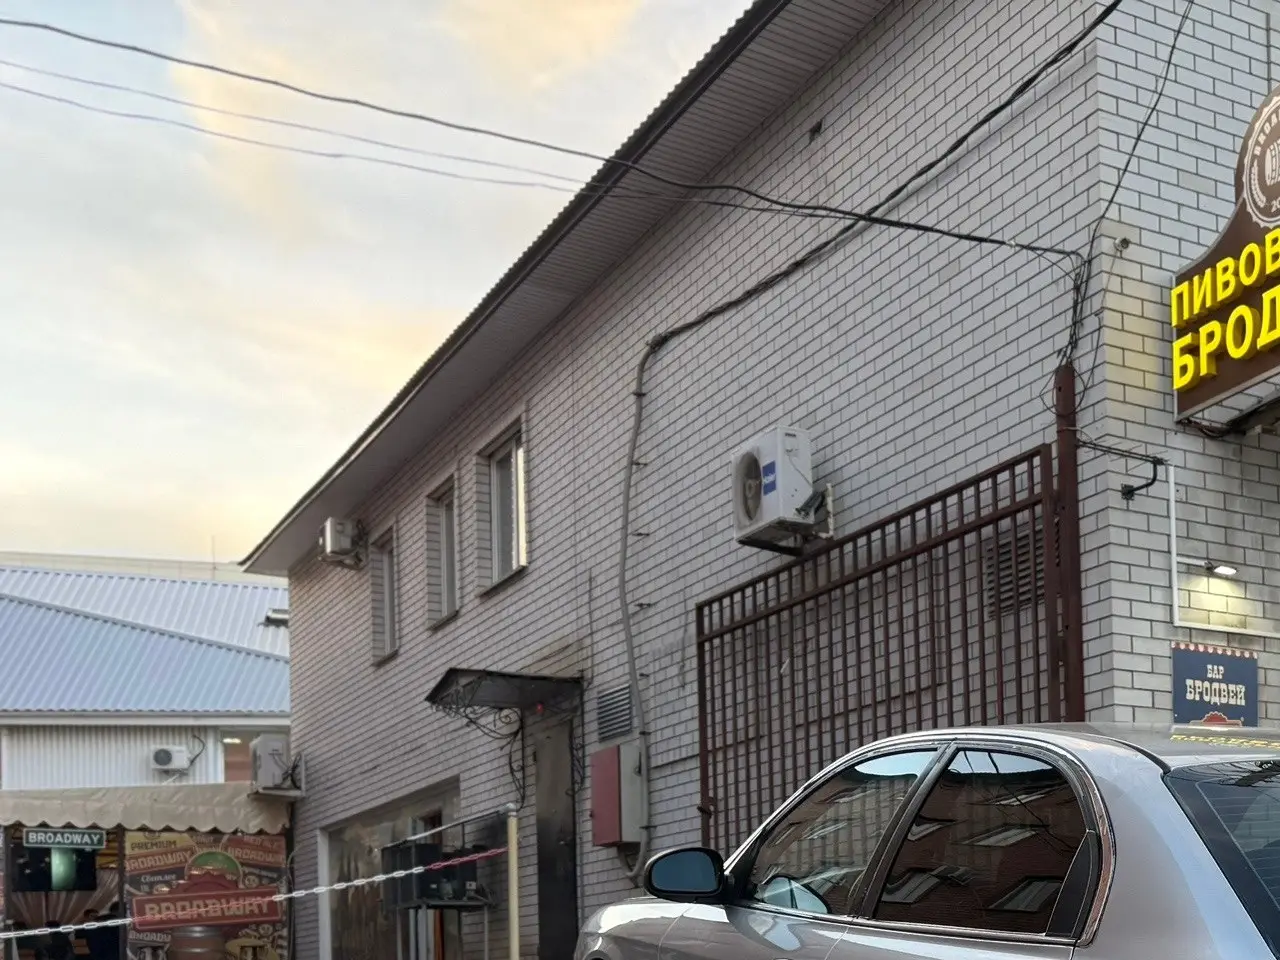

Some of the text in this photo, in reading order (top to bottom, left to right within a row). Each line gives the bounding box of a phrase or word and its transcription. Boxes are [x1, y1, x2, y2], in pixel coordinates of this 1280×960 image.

[1206, 664, 1225, 679] БАР
[1185, 678, 1246, 707] БРОДВЕЙ
[28, 832, 101, 844] BROADWAY
[130, 839, 178, 851] PREMIUM
[144, 896, 271, 921] BROADWAY
